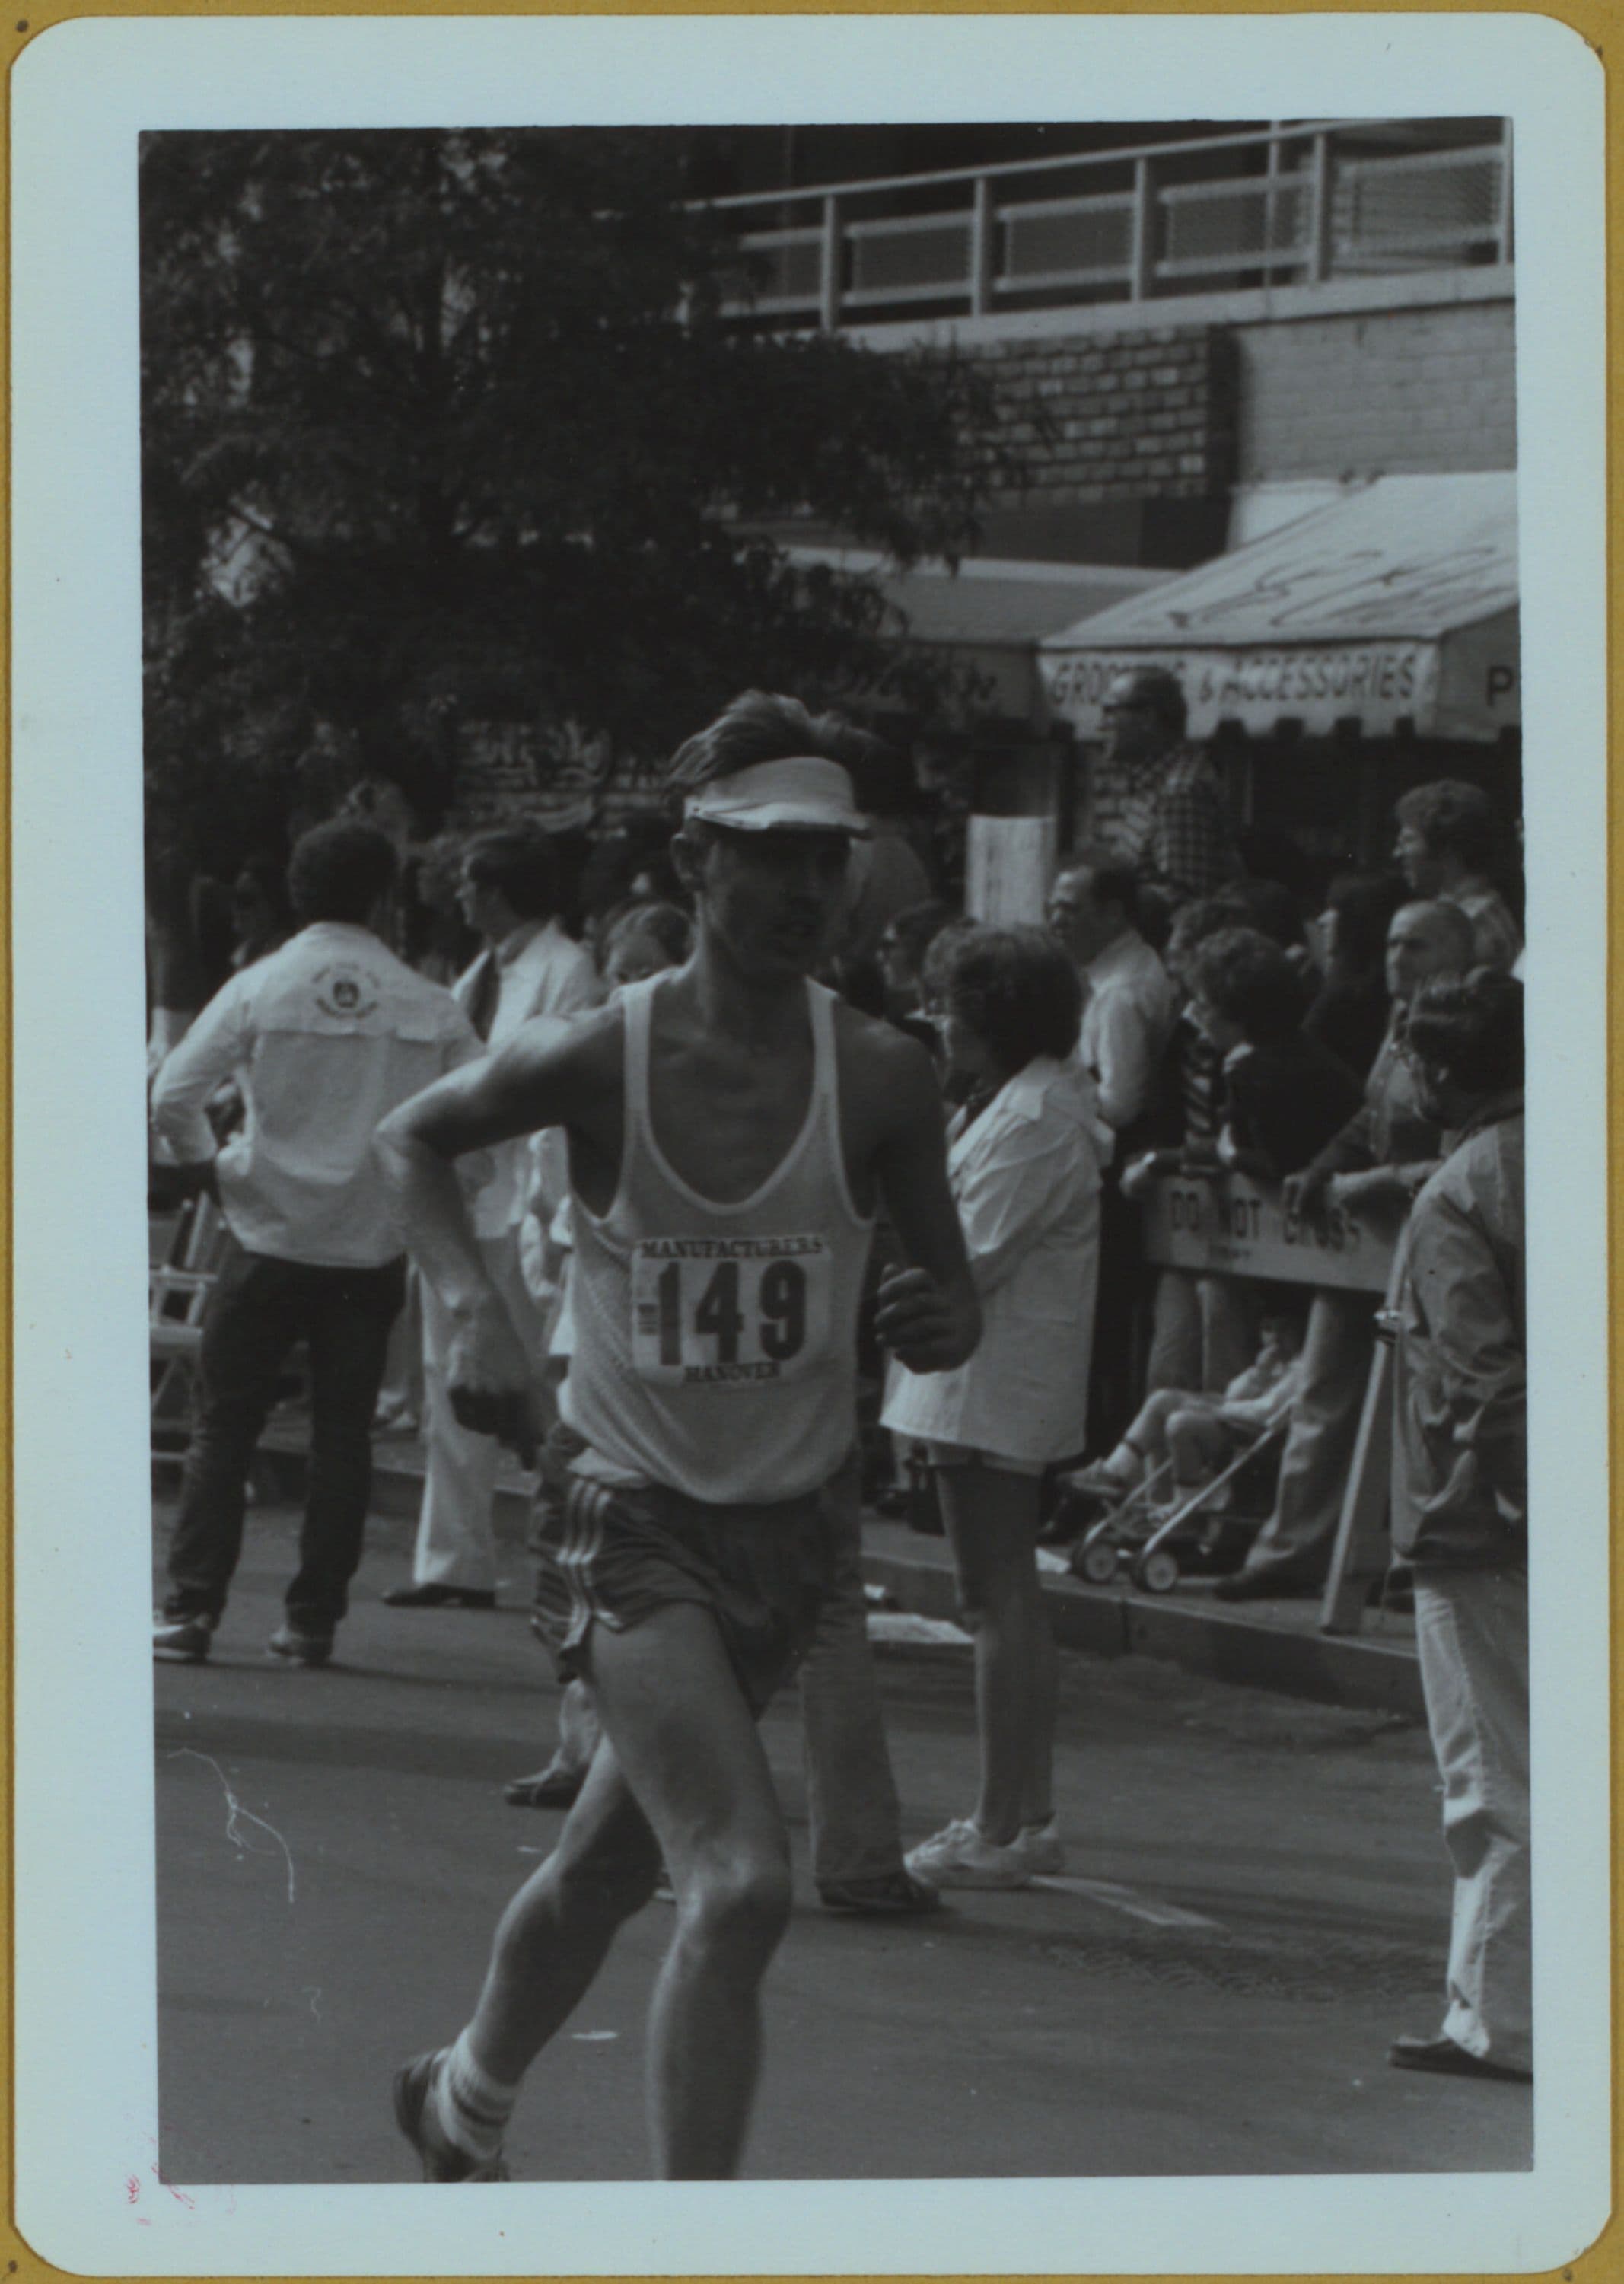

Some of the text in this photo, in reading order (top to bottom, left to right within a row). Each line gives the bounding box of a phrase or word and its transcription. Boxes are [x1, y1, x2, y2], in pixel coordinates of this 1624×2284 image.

[1219, 652, 1415, 702] ACCESSORIES
[1170, 1190, 1200, 1232] DO
[640, 1236, 823, 1258] MANUFACTURERS
[658, 1260, 807, 1367] 149
[685, 1362, 782, 1383] HANOVER
